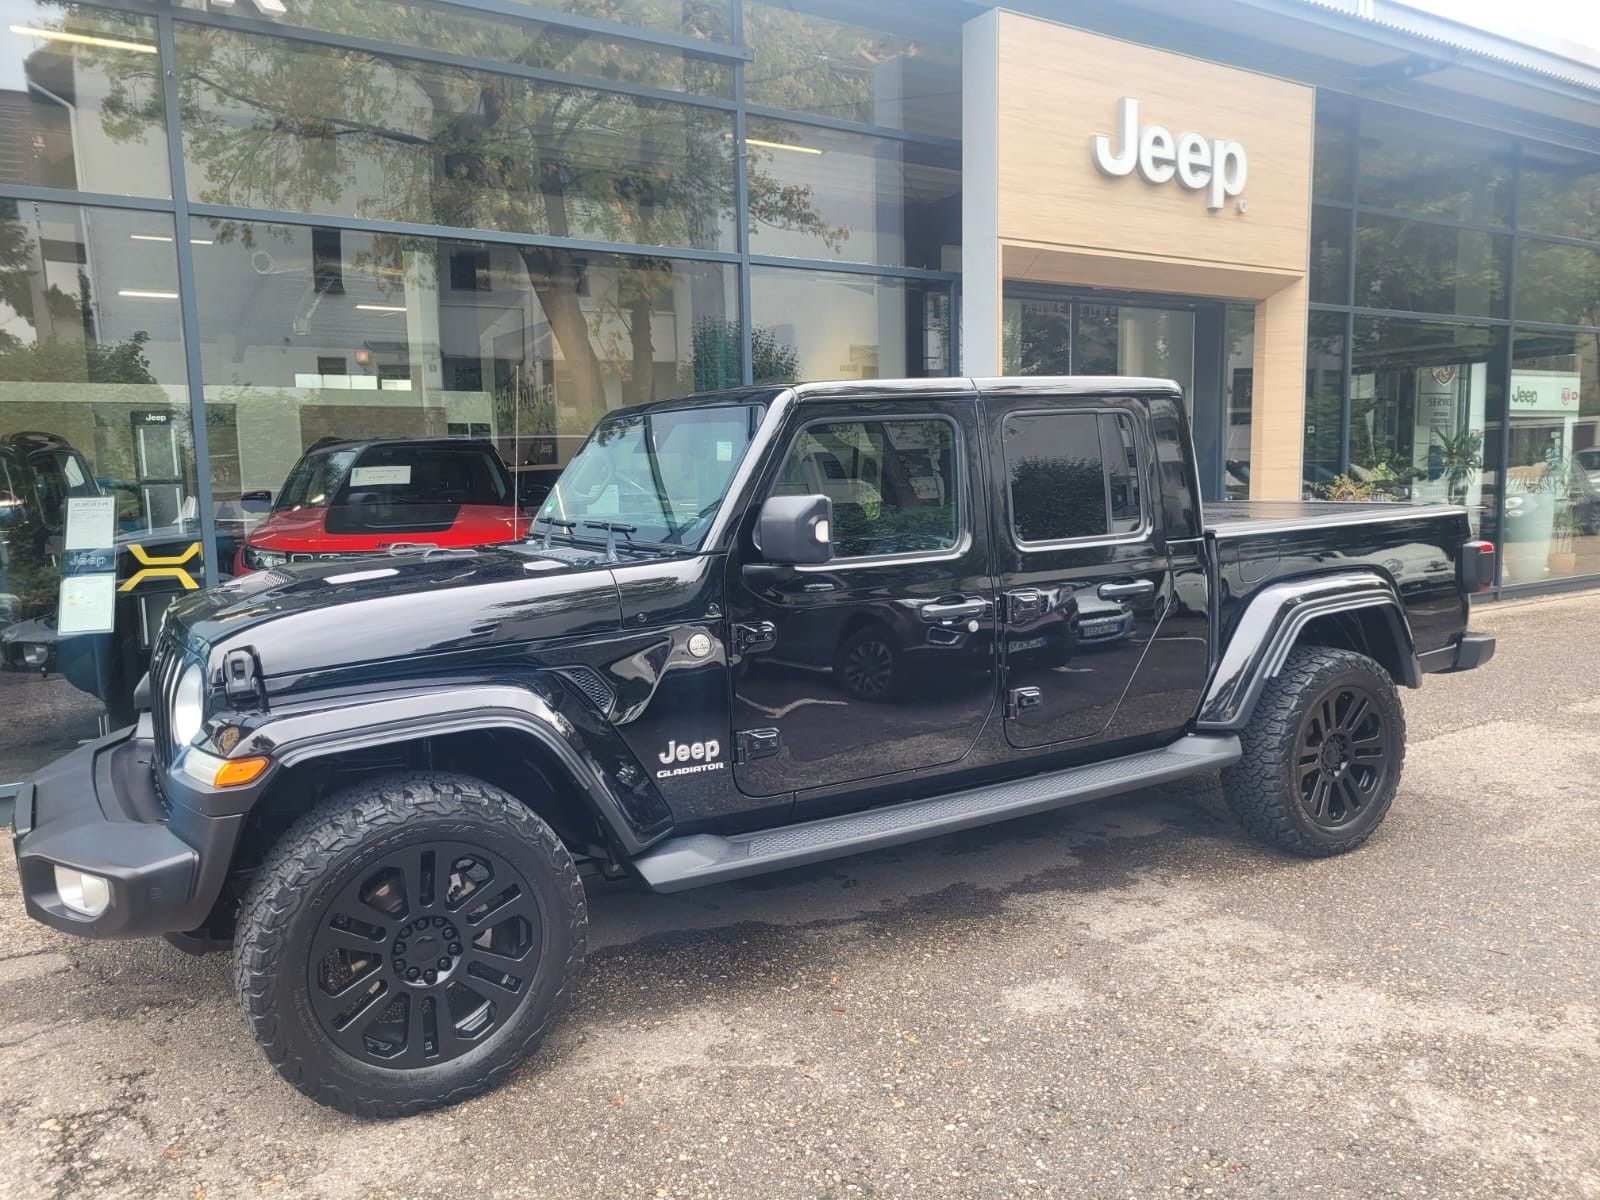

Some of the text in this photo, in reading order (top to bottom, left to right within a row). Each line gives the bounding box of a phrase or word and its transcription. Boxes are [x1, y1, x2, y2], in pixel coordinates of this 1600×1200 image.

[1090, 96, 1248, 211] Jeep
[1512, 386, 1538, 406] Jeep
[145, 413, 167, 422] Jeep
[69, 552, 106, 567] Jeep
[659, 739, 720, 764] Jeep
[656, 762, 724, 778] GLADIATOR
